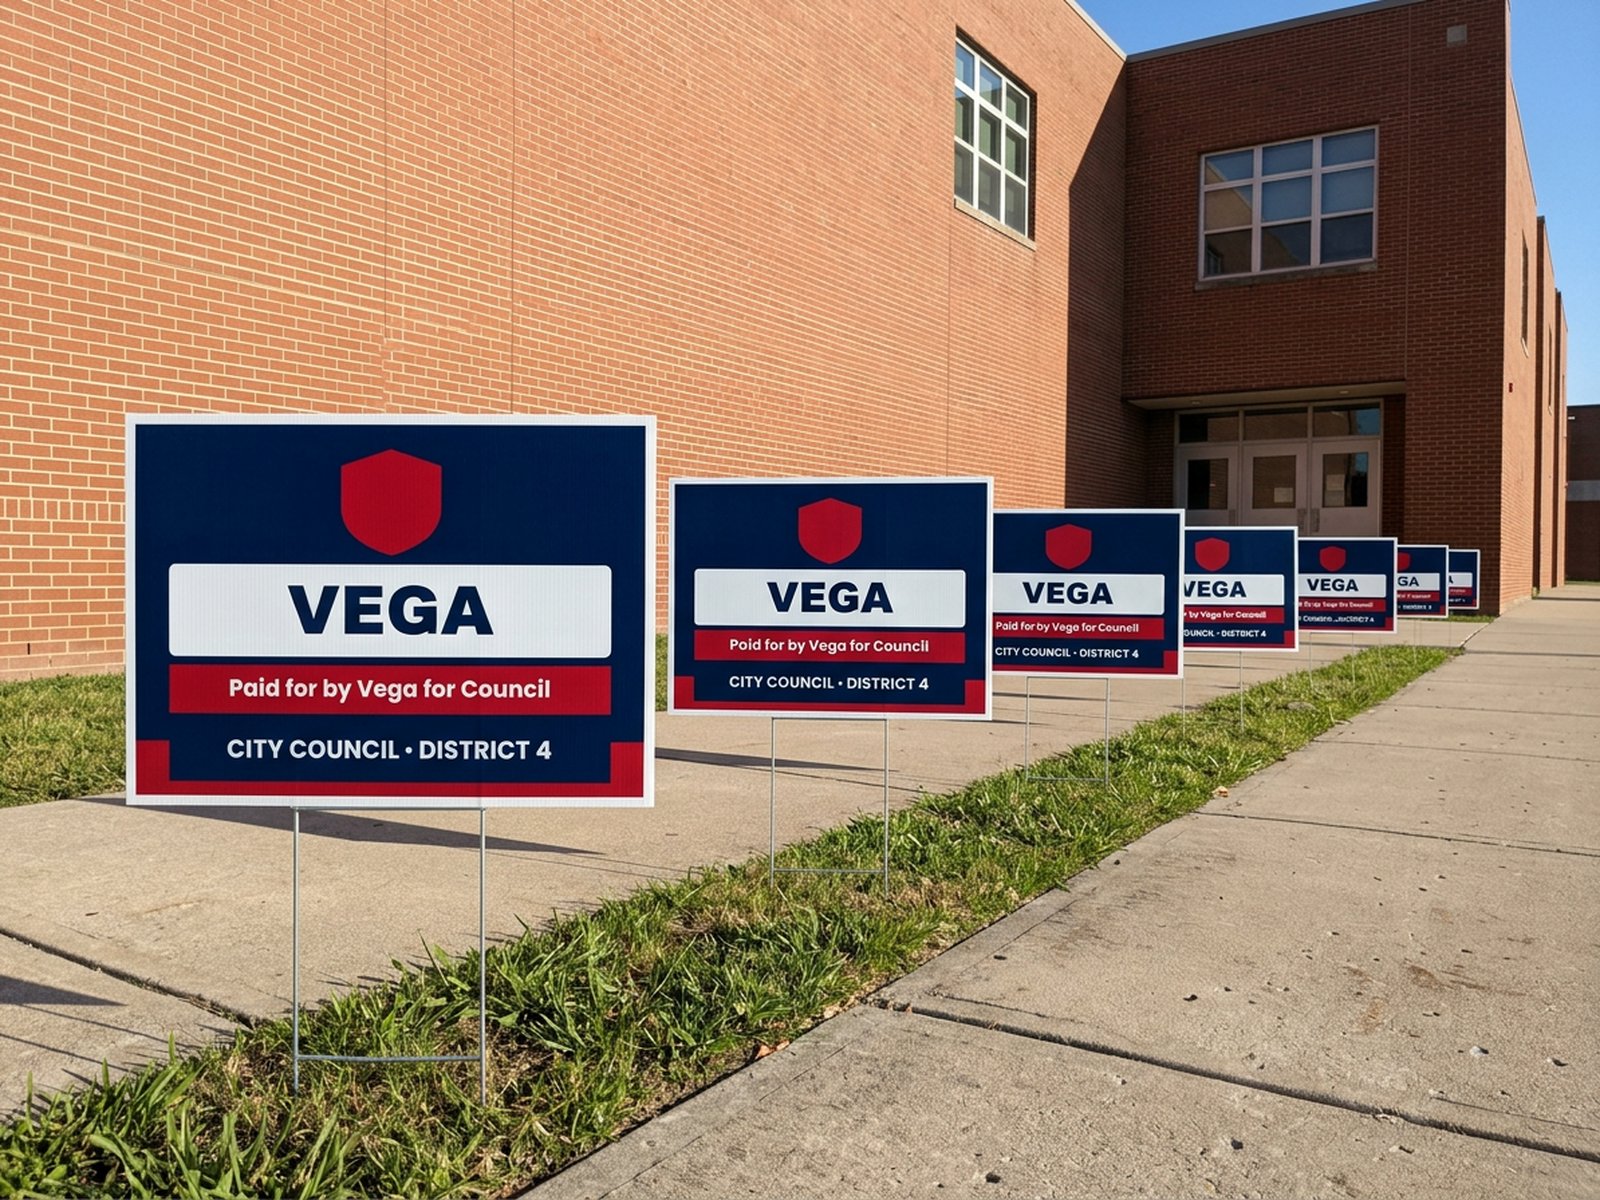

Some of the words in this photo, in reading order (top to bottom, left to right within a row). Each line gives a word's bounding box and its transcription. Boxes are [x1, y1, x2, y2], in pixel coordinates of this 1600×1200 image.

[1022, 582, 1114, 605] VEGA
[1307, 578, 1359, 592] VEGA
[767, 582, 894, 614] VEGA
[287, 584, 494, 636] VEGA
[764, 638, 785, 651] for
[788, 639, 806, 655] by
[809, 640, 847, 655] Vega
[849, 639, 871, 652] for
[873, 640, 929, 653] Council
[994, 647, 1021, 657] CITY
[1021, 648, 1072, 658] COUNCIL
[229, 677, 280, 698] Paid
[285, 678, 318, 698] for
[323, 679, 352, 704] by
[357, 680, 418, 704] Vega
[423, 679, 456, 698] for
[461, 679, 551, 699] Council
[729, 676, 764, 688] CITY
[766, 676, 835, 689] COUNCIL
[846, 677, 916, 690] DISTRICT
[918, 678, 930, 690] 4
[227, 739, 284, 759] CITY
[289, 739, 400, 760] COUNCIL
[419, 740, 531, 760] DISTRICT
[536, 740, 552, 760] 4
